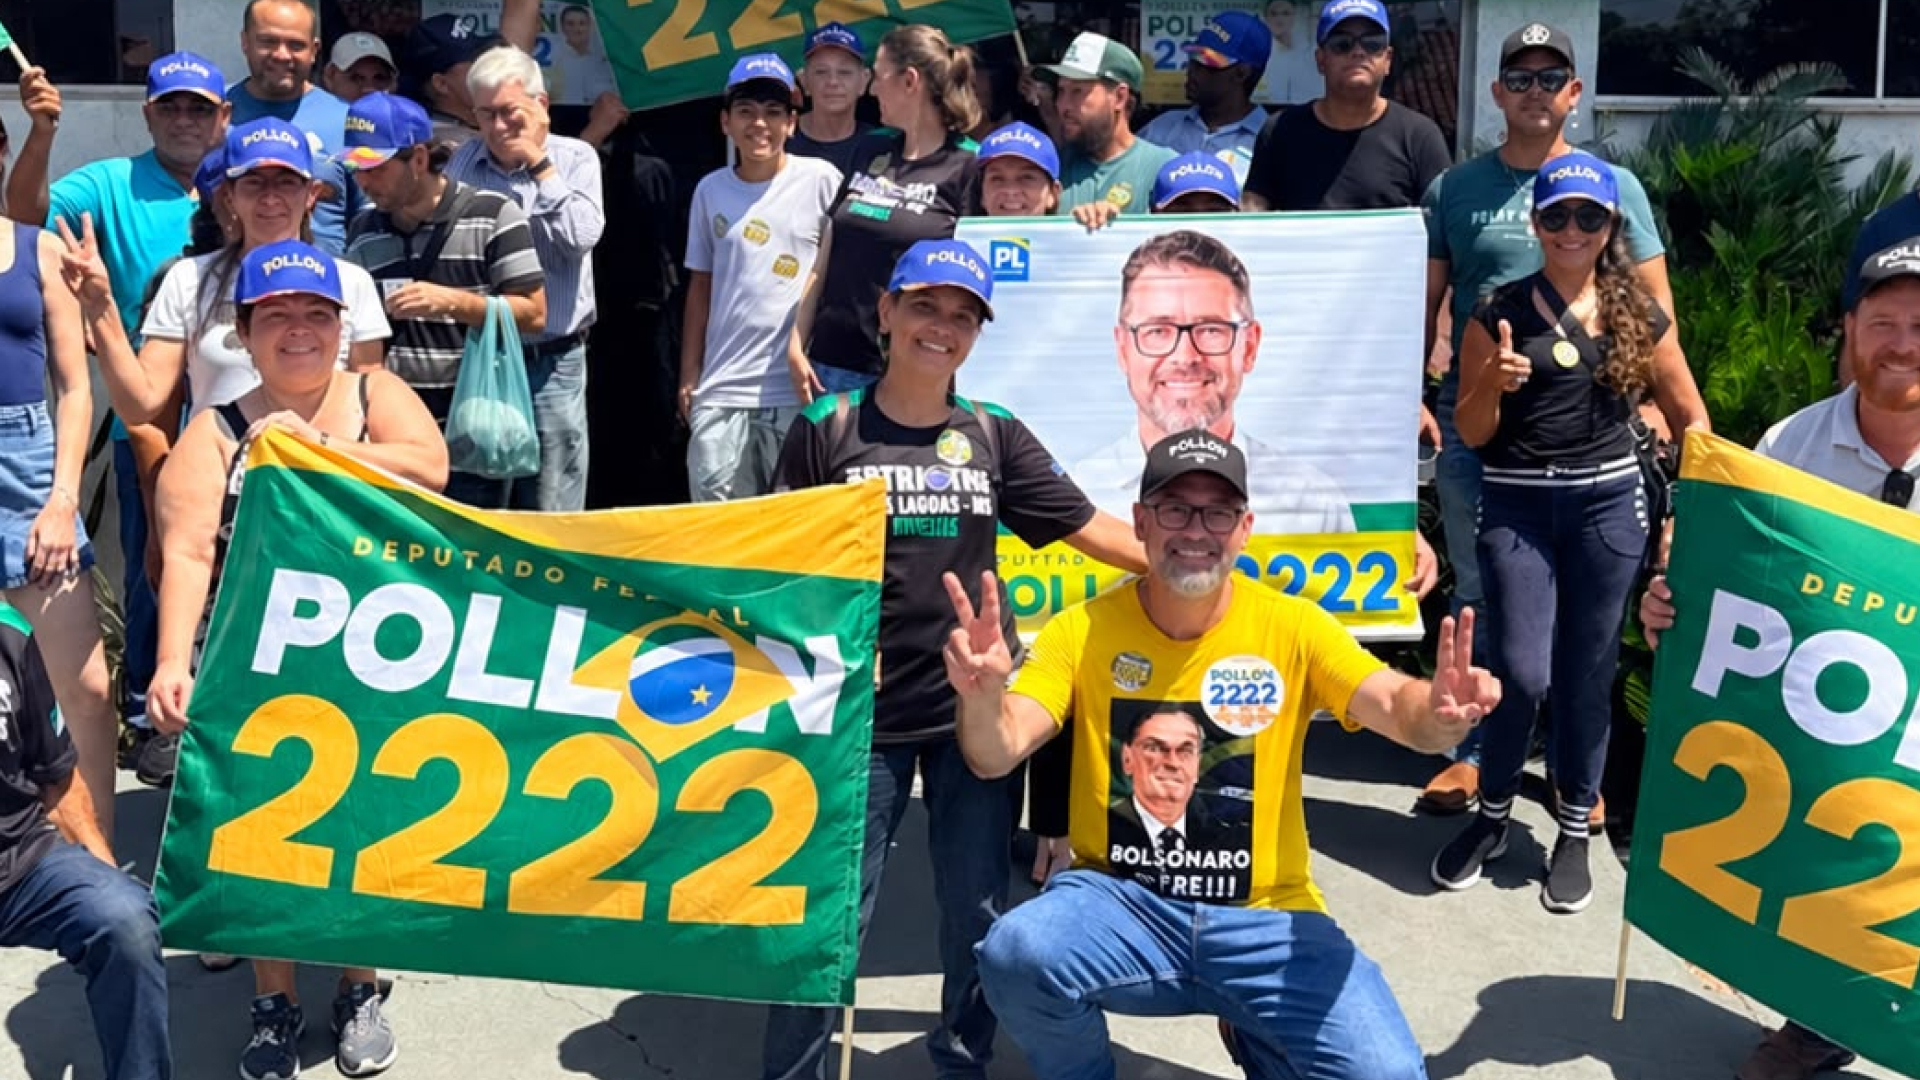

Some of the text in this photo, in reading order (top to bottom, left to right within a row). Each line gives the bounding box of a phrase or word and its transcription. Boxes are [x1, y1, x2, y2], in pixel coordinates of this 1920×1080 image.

[1548, 164, 1600, 184] POLLON
[261, 253, 326, 280] POLLON
[925, 250, 986, 281] POLLON
[996, 245, 1025, 268] PL
[1168, 437, 1228, 459] POLLON
[352, 536, 566, 584] DEPUTADO
[1800, 572, 1918, 625] DEPU
[251, 567, 849, 736] POLLON
[1209, 682, 1278, 706] 2222
[207, 693, 820, 926] 2222
[1110, 845, 1251, 870] BOLSONARO
[1659, 719, 1920, 991] 22
